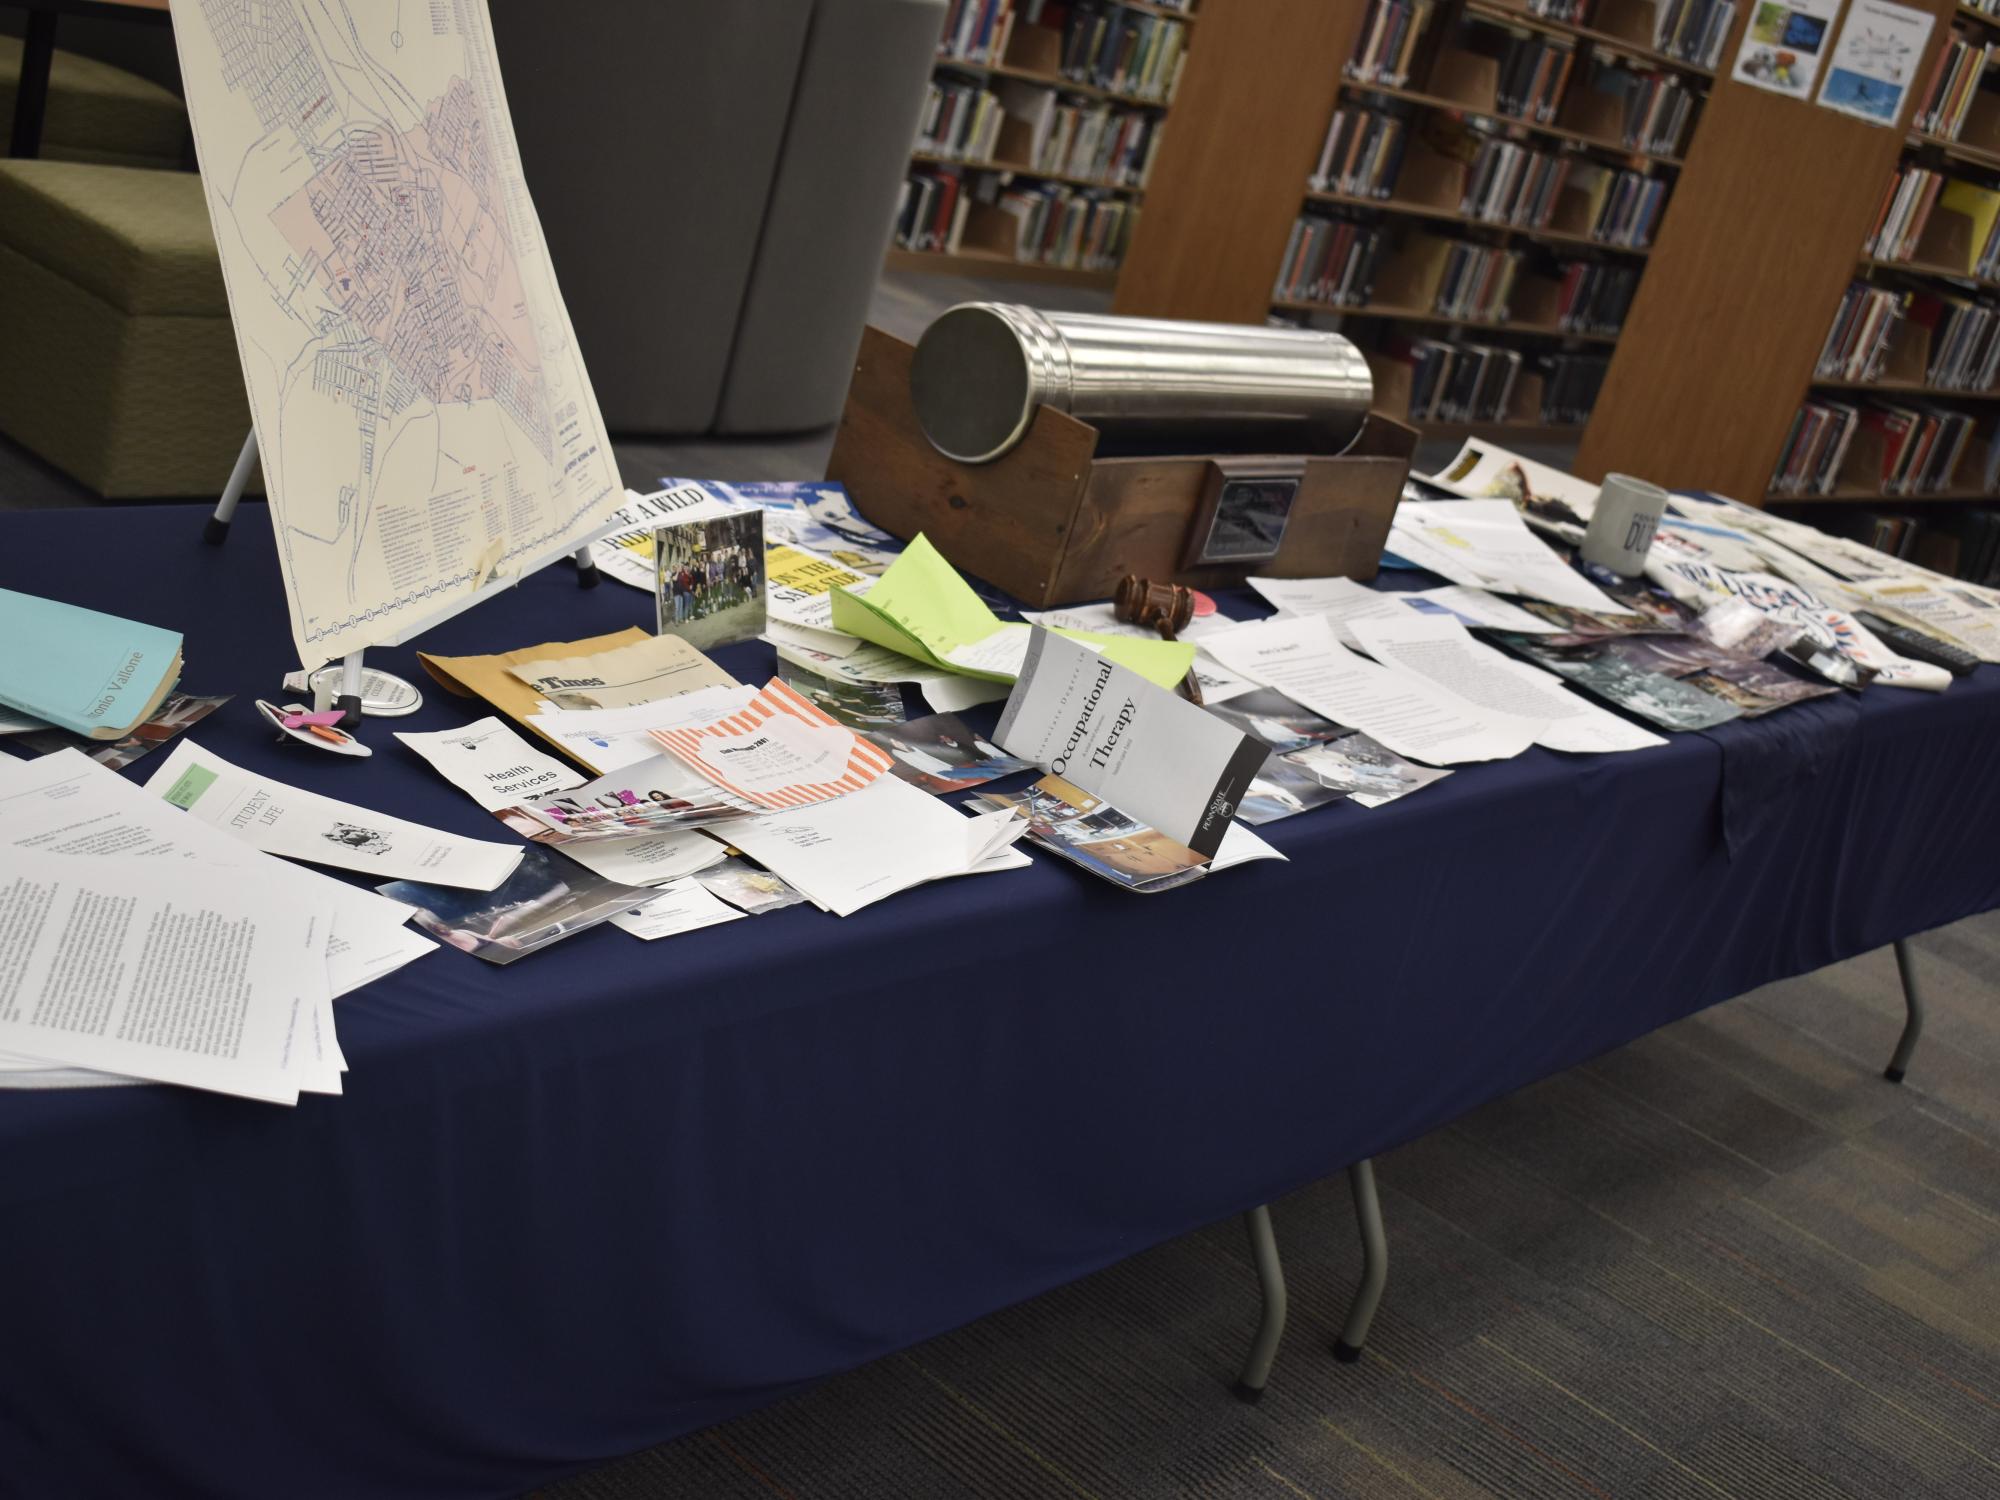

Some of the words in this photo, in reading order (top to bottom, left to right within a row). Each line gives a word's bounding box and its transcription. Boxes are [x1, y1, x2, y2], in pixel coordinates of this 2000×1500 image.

[649, 488, 705, 513] WILD
[108, 651, 144, 692] Vallone
[537, 676, 606, 690] Times
[1051, 659, 1113, 776] Occupational
[1089, 696, 1137, 769] Therapy
[484, 763, 534, 783] Health
[492, 770, 558, 794] Services
[230, 789, 271, 829] STUDENT
[259, 805, 285, 827] LIFE
